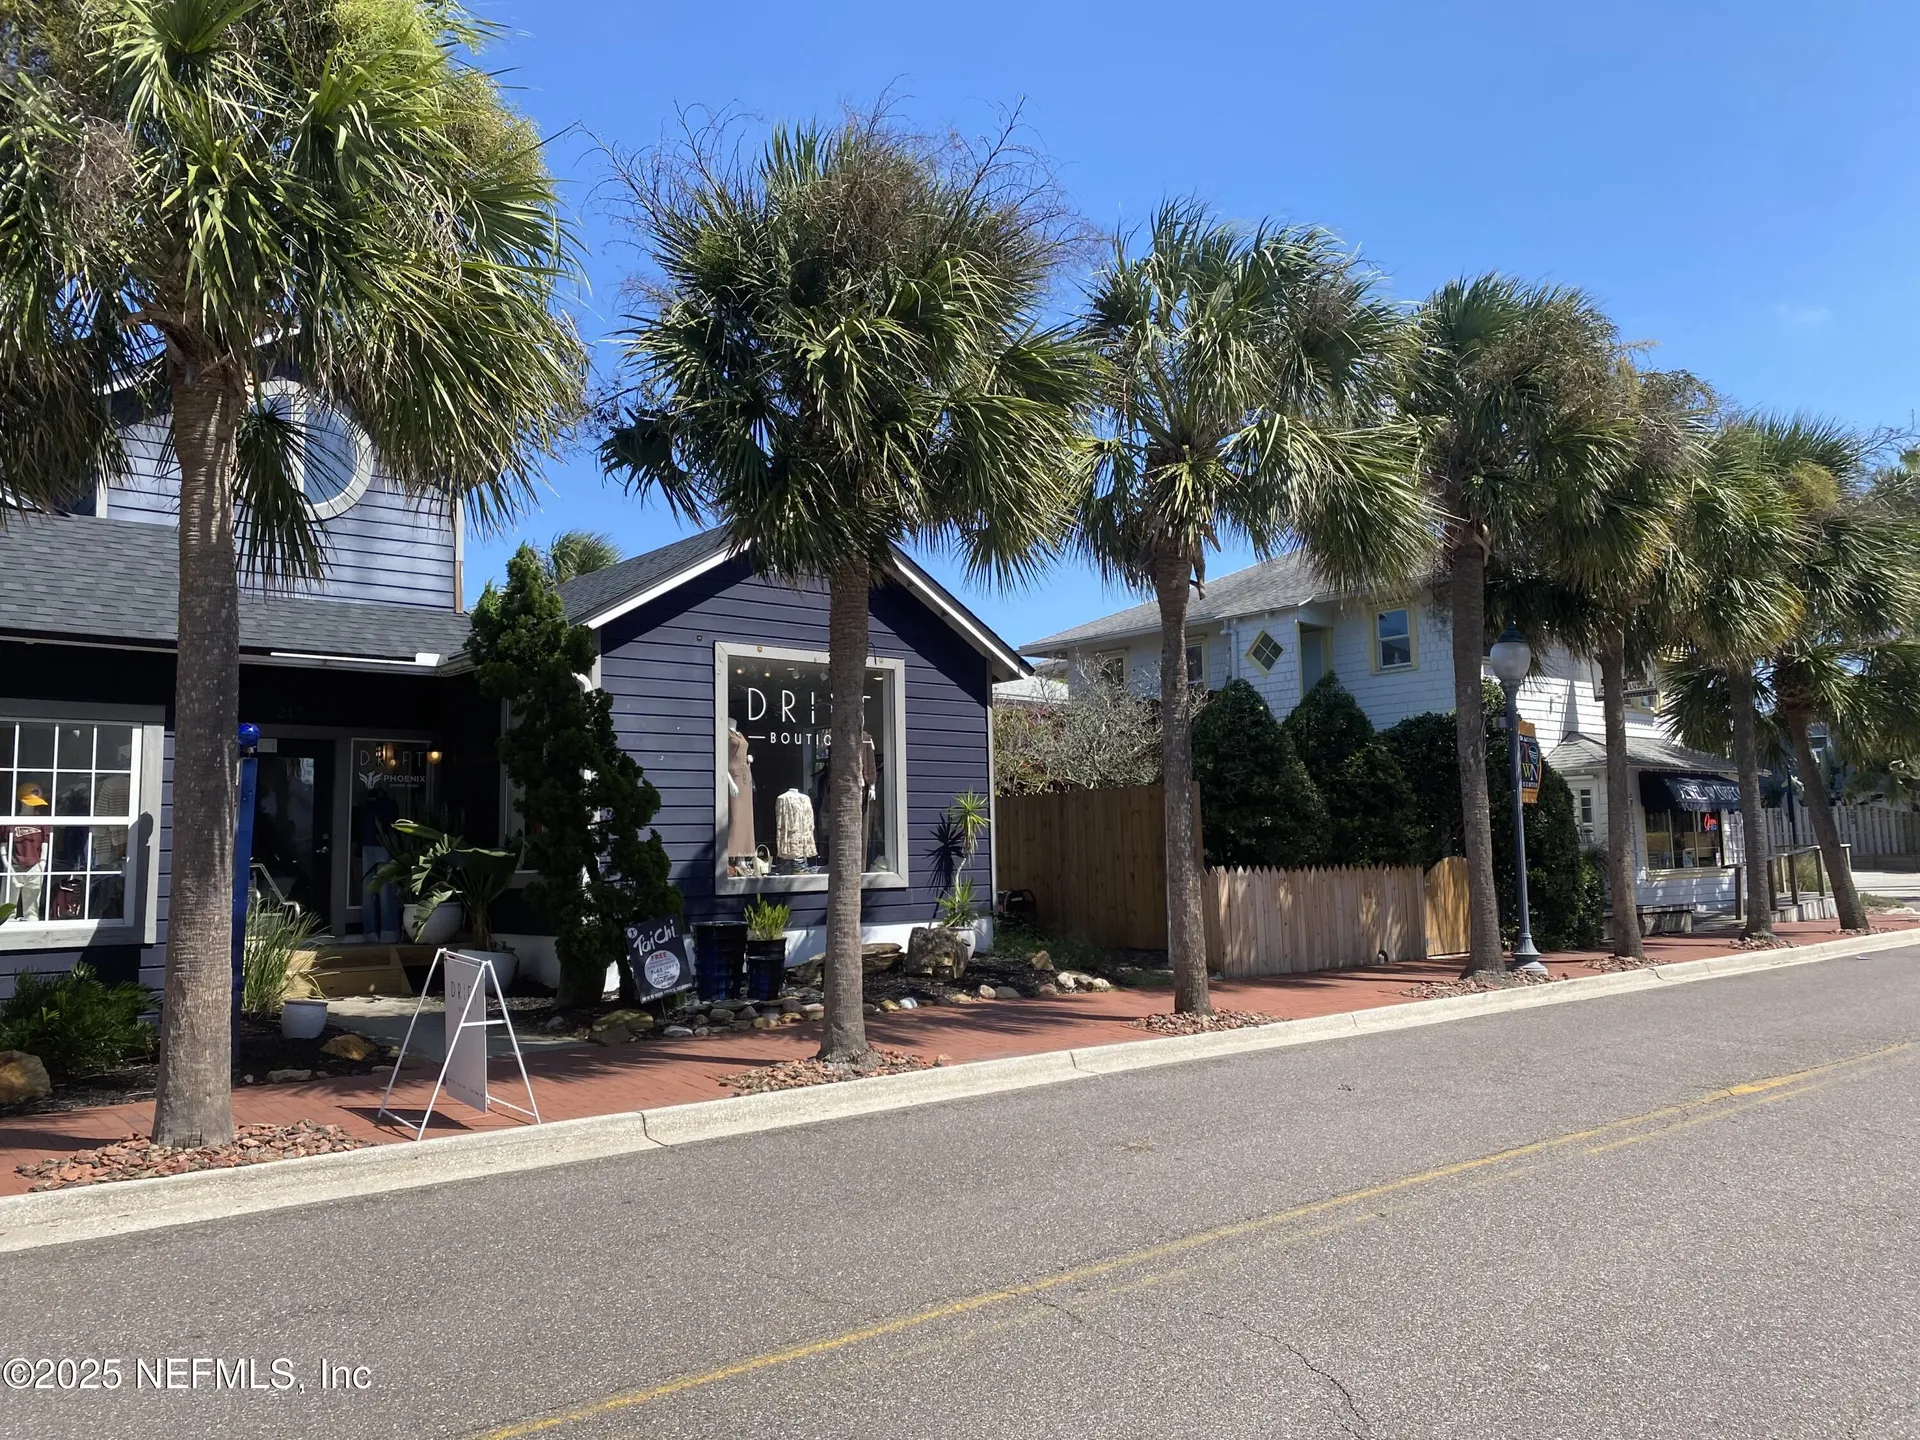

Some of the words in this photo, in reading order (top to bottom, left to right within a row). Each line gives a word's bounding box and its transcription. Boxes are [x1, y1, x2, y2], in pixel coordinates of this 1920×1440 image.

[383, 774, 426, 783] PHOENIX
[633, 930, 655, 956] Tai
[654, 919, 676, 944] Chi
[650, 951, 668, 961] FREE
